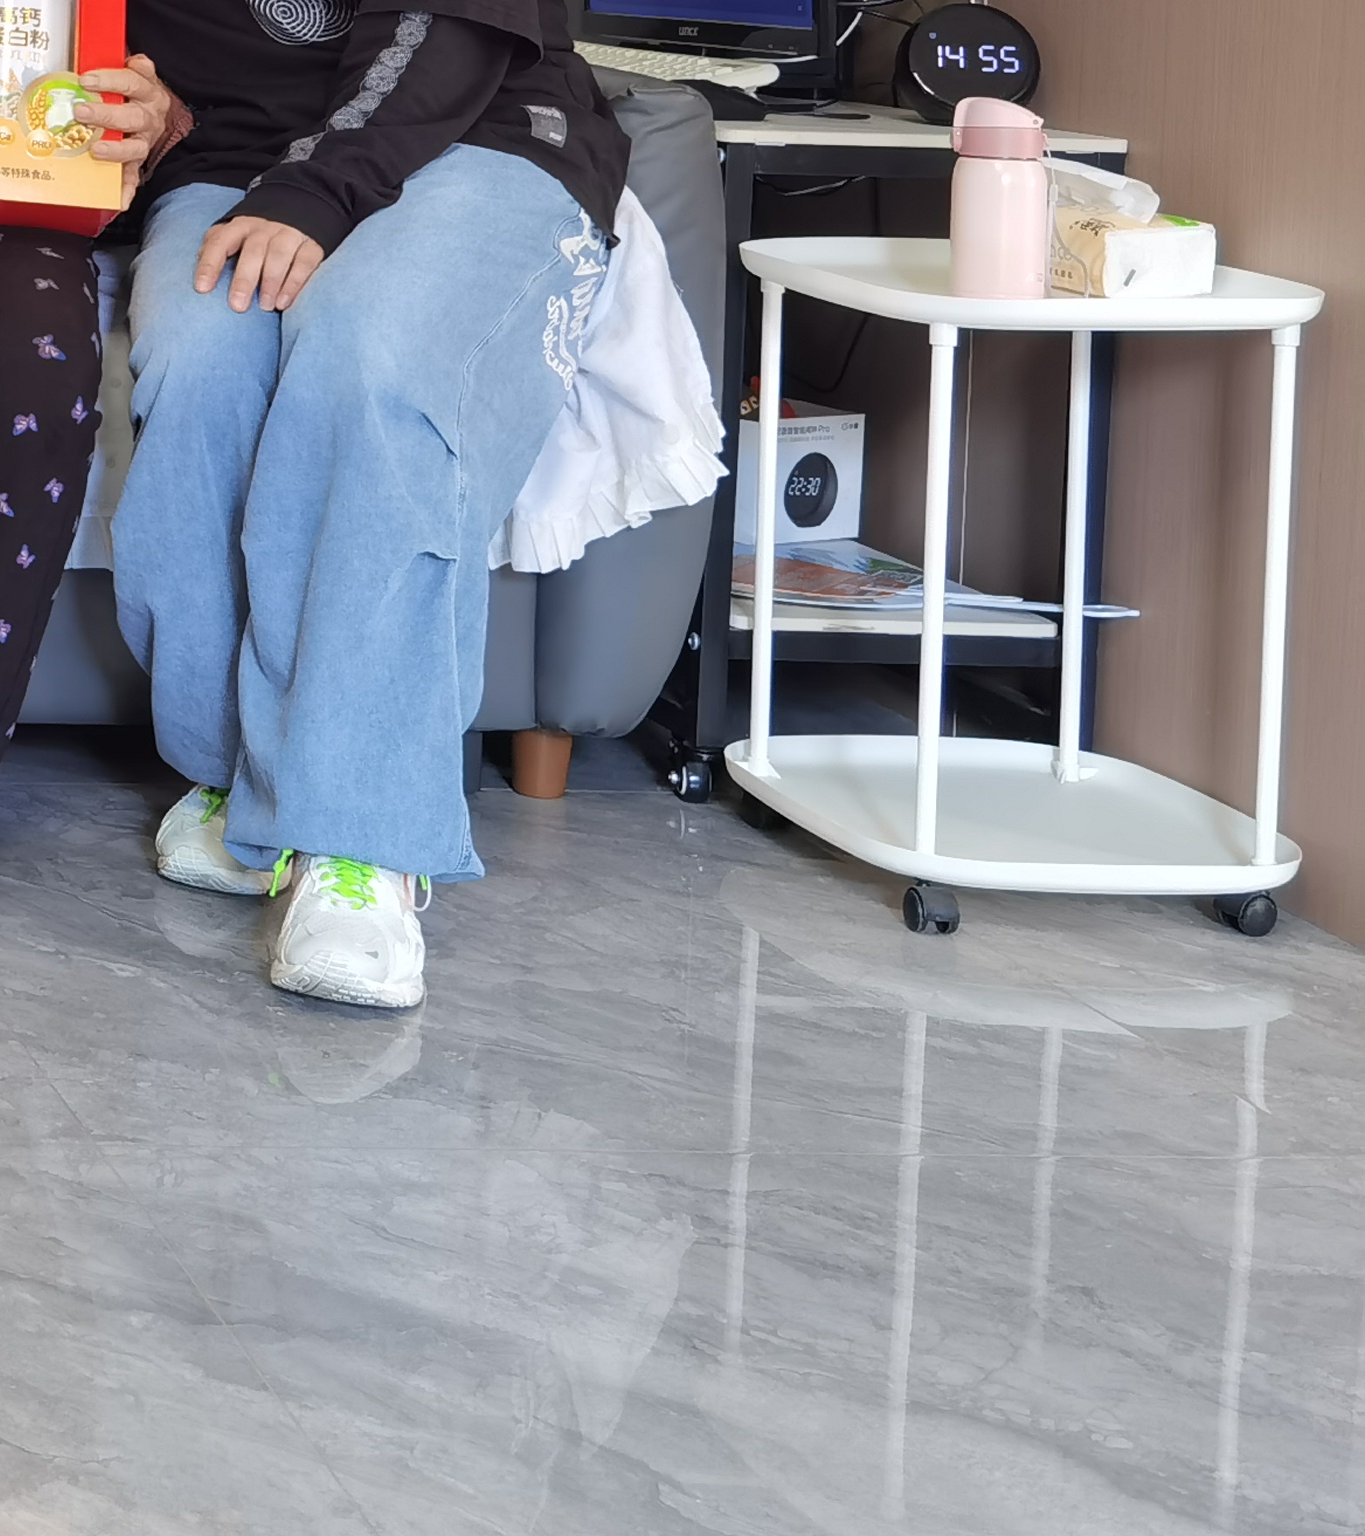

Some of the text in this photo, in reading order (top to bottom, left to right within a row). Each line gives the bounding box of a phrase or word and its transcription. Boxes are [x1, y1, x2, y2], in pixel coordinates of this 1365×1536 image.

[937, 45, 1020, 73] 14 55
[788, 477, 822, 496] 22:30
